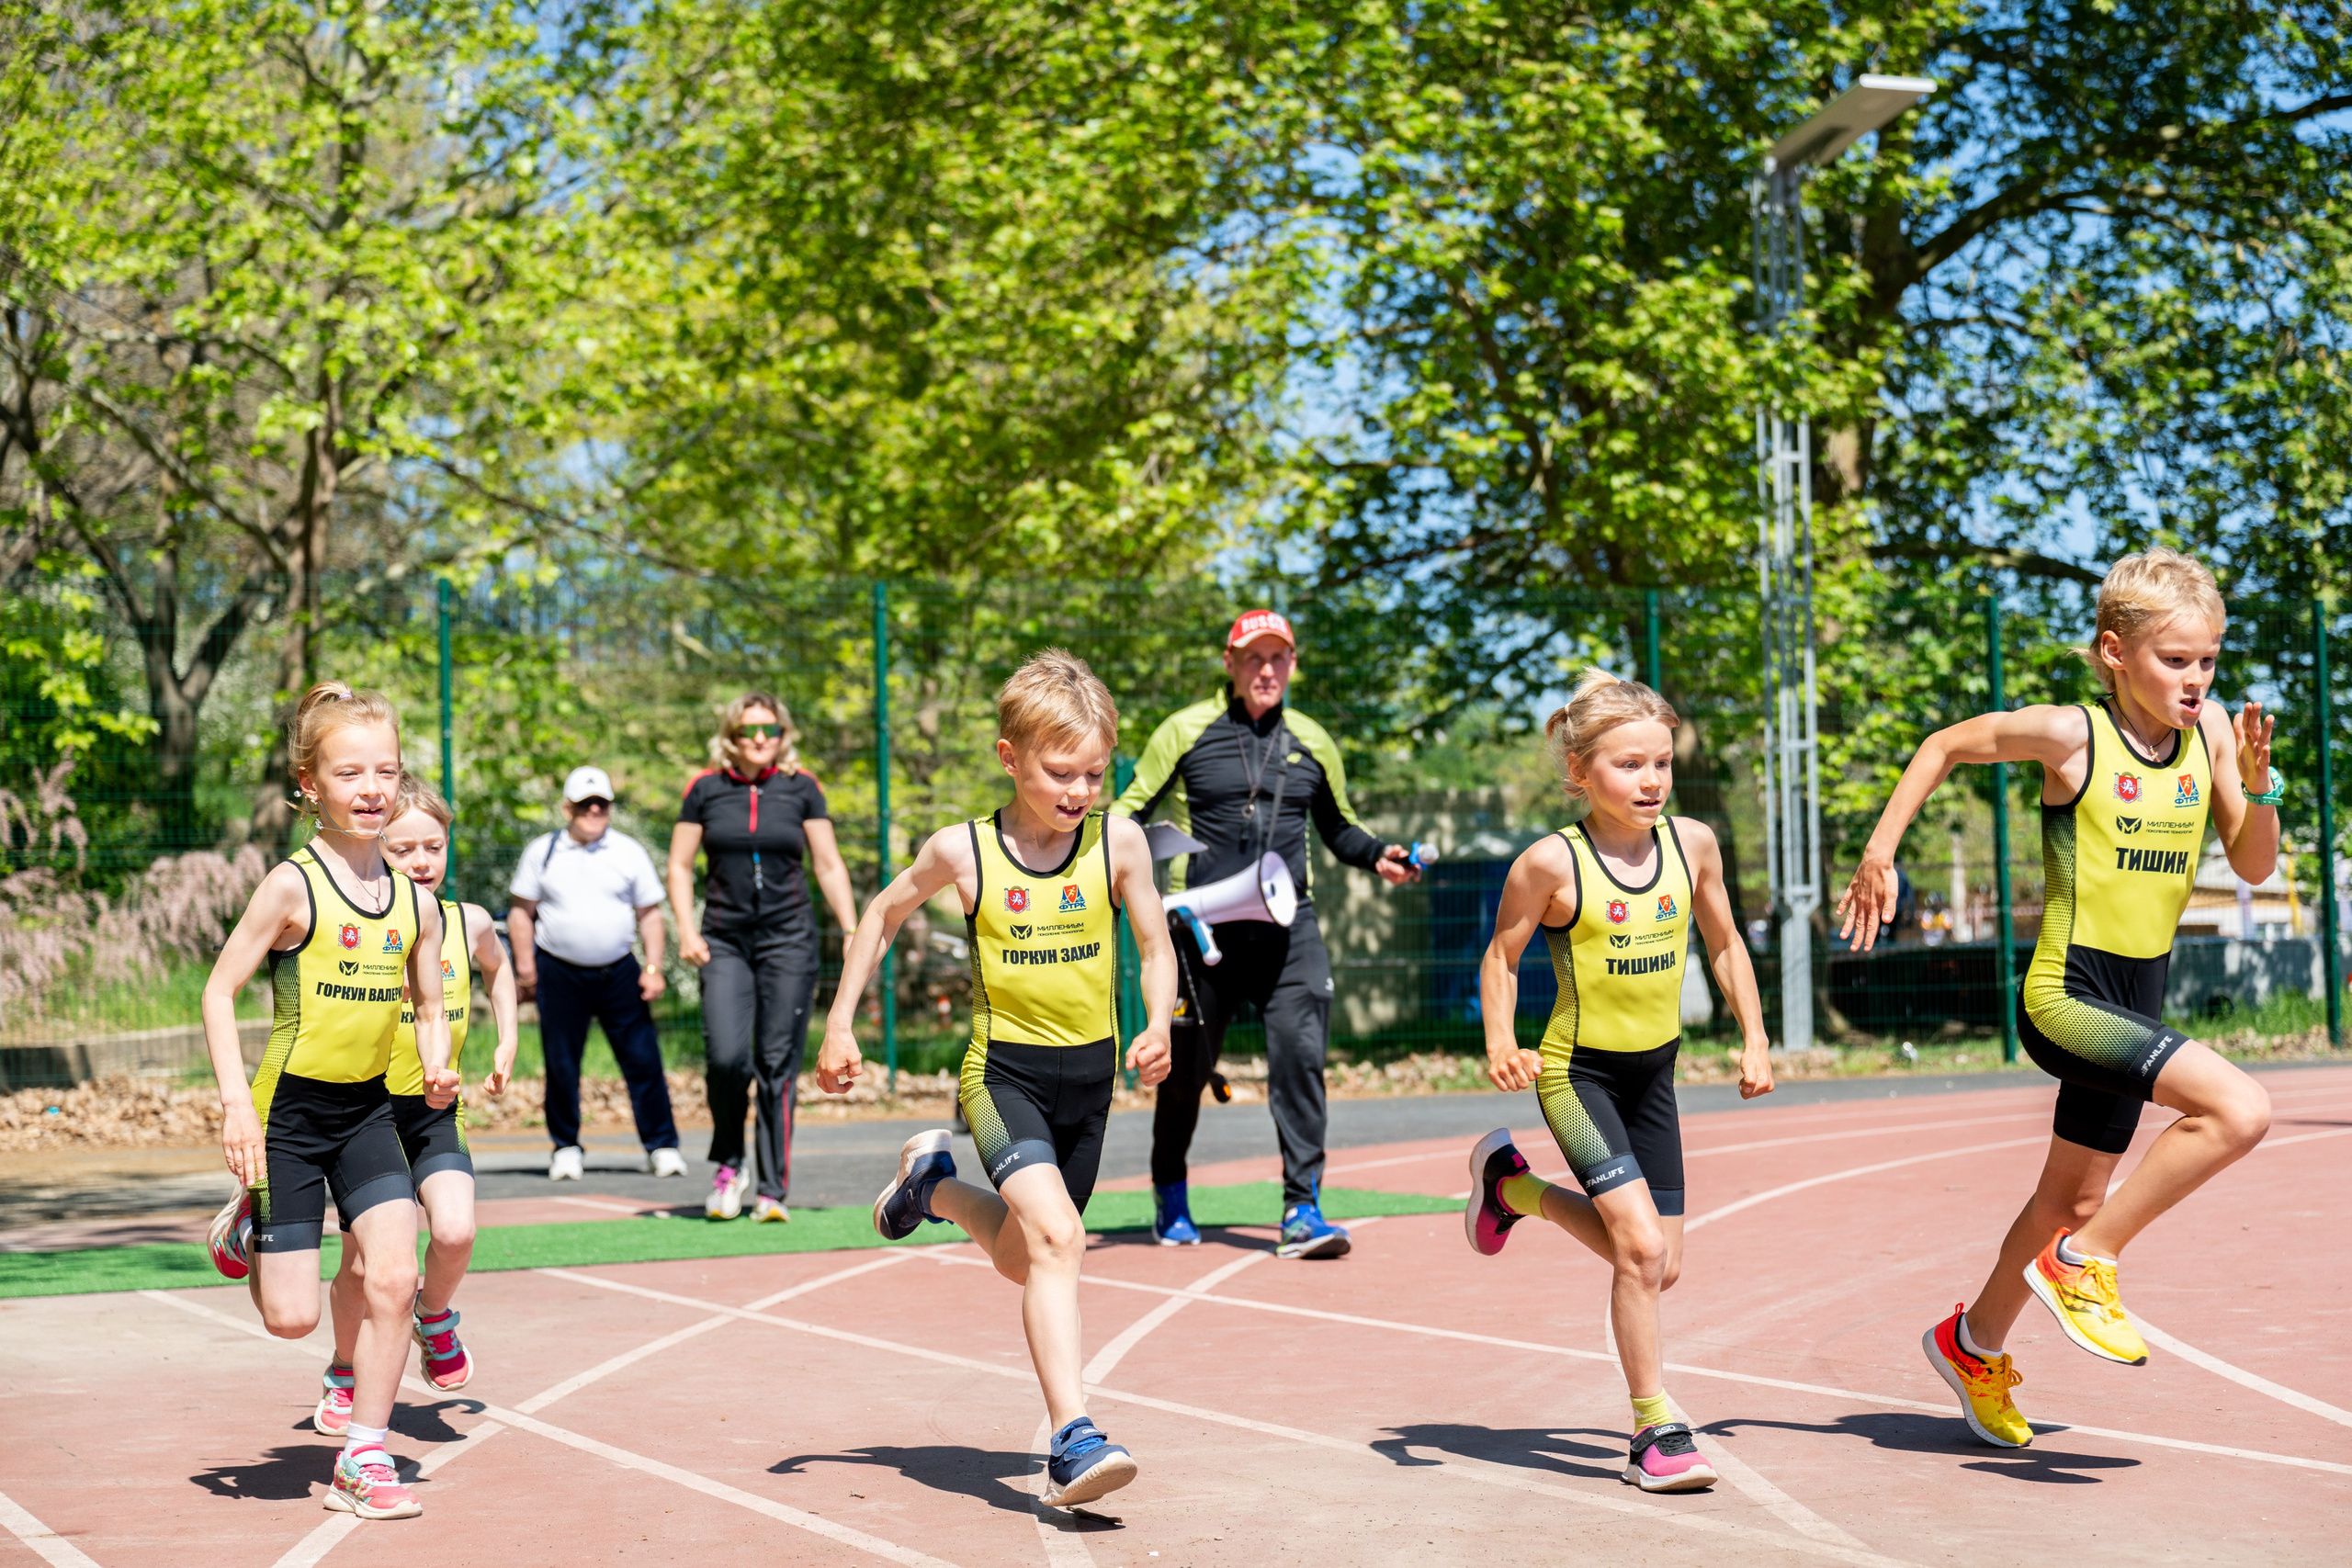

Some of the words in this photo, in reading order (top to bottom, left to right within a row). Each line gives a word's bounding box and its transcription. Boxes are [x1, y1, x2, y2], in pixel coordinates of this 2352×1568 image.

[2174, 795, 2199, 805] ФТРК
[2115, 847, 2188, 874] ТИШИН
[1058, 902, 1086, 910] ФТРК
[1655, 910, 1678, 919] ФТРК
[1002, 949, 1057, 964] ГОРКУН
[1060, 942, 1100, 963] ЗАХАР
[1605, 950, 1676, 975] ТИШИНА
[316, 982, 366, 1001] ГОРКУН
[2142, 1035, 2173, 1077] FANLIFE
[1586, 1167, 1625, 1188] FANLIFE
[1654, 1425, 1677, 1436] GSD
